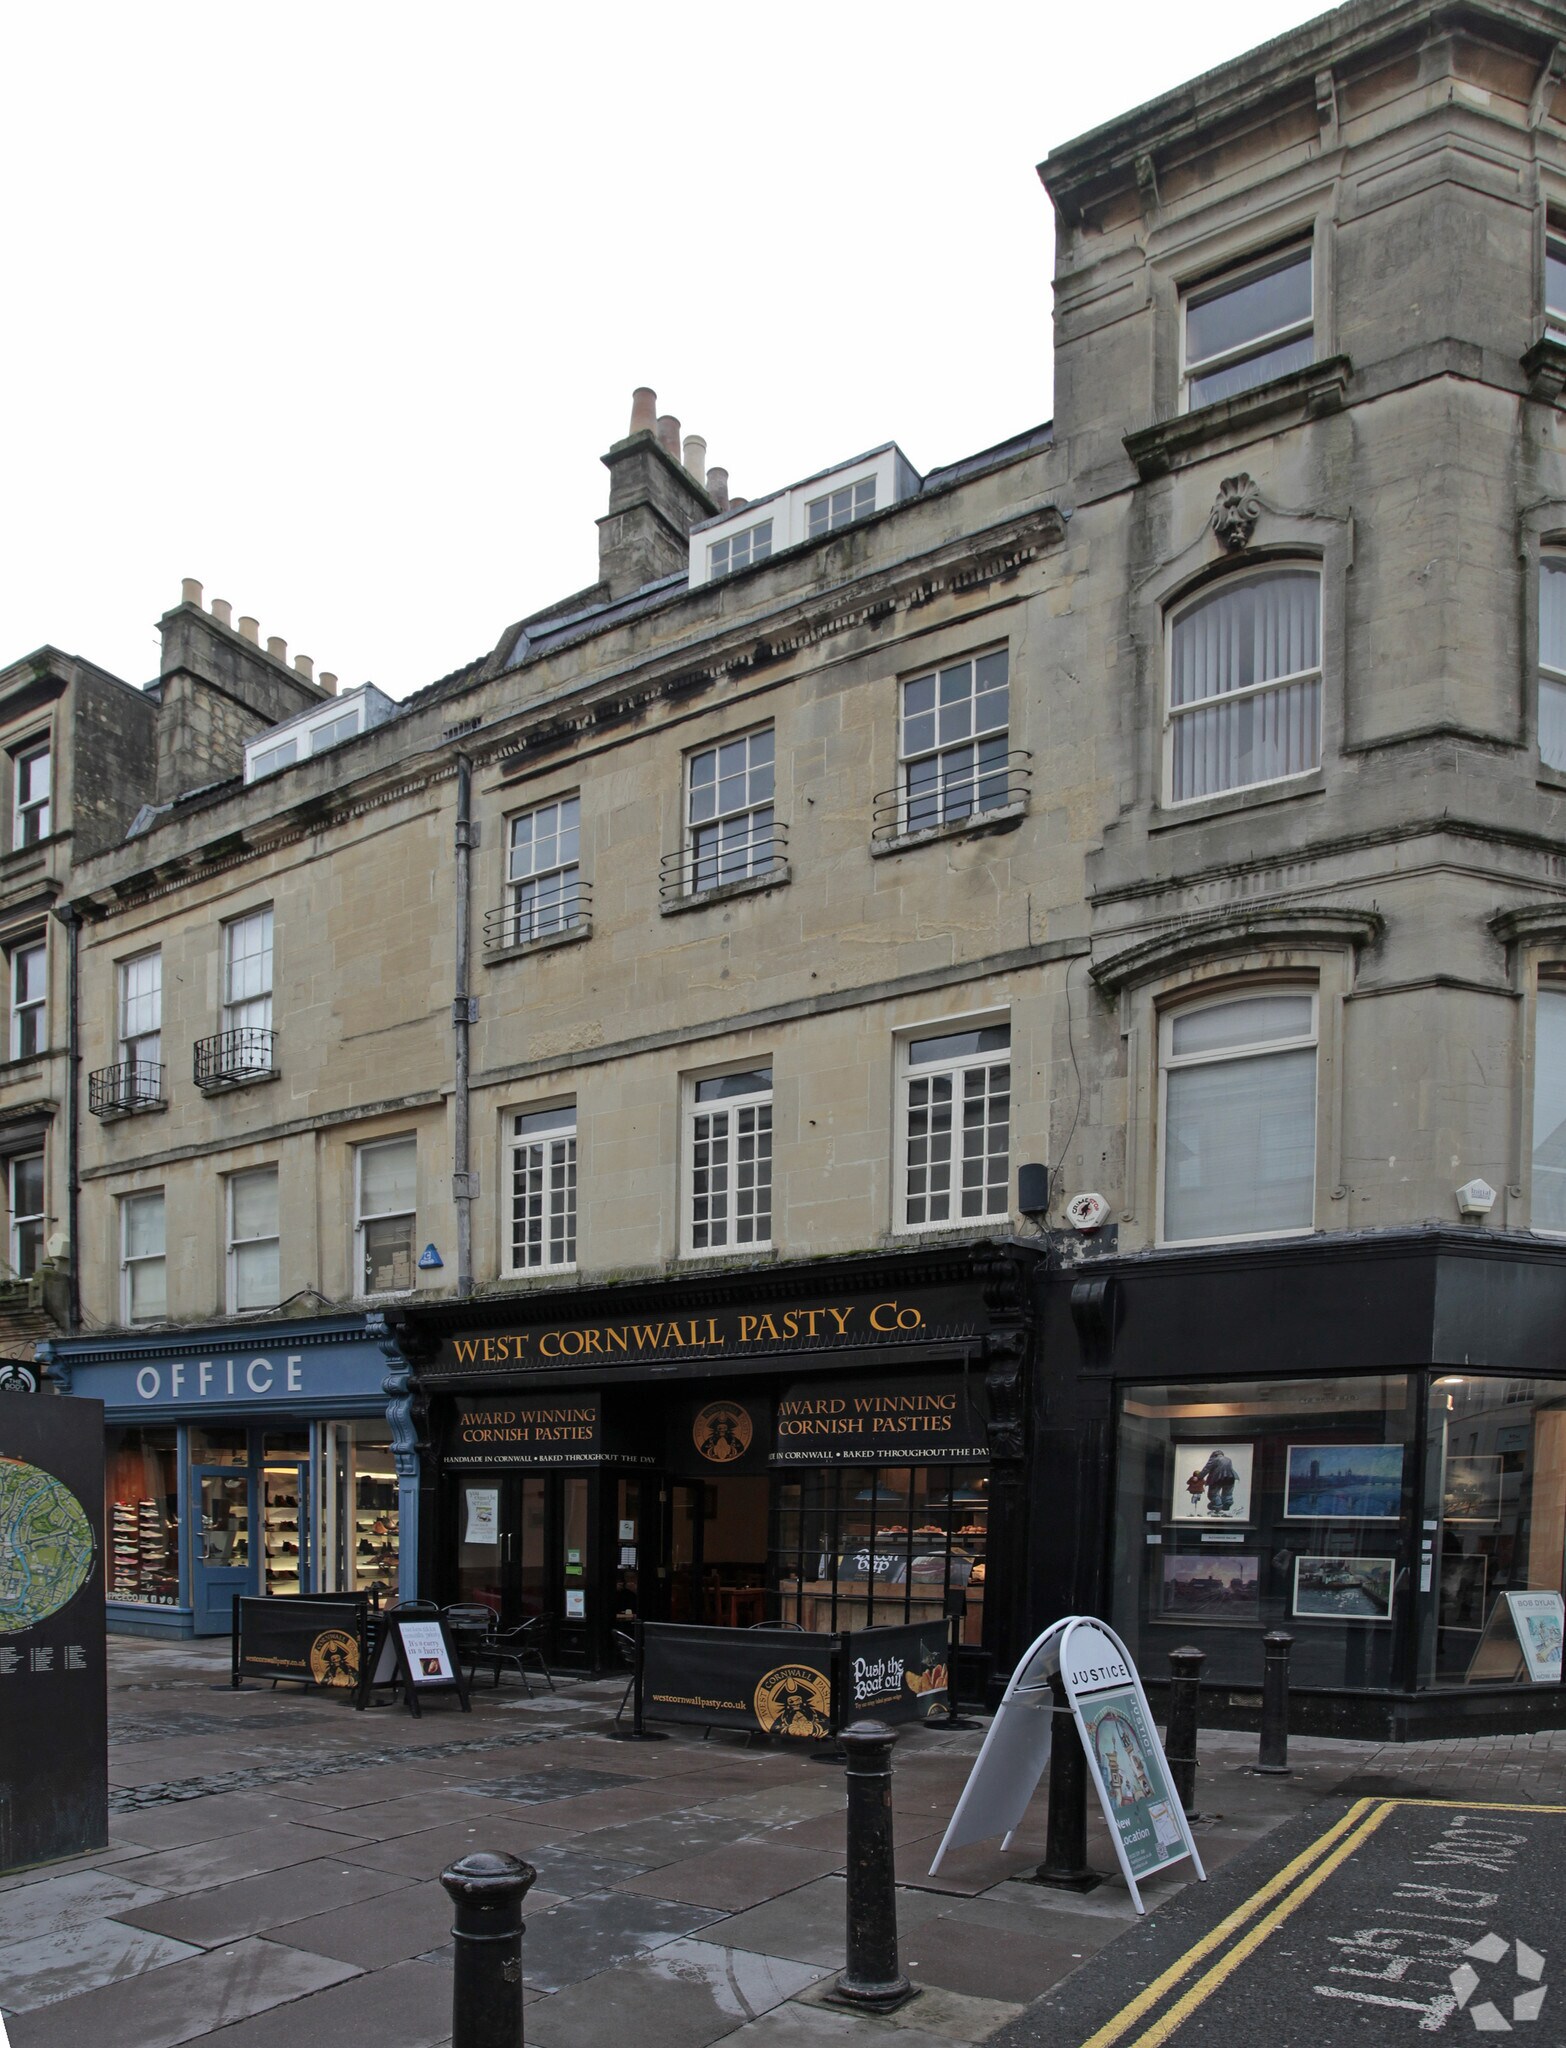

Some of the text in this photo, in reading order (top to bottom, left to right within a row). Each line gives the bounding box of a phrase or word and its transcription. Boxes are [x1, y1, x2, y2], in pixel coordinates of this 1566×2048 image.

[452, 1300, 926, 1363] WEST CORNWALL PASTY Co.
[136, 1355, 302, 1400] OFFICE
[777, 1394, 957, 1417] AWARD WINNING
[460, 1408, 596, 1426] AWARD WINNING
[778, 1415, 952, 1436] CORNISH PASTIES
[462, 1426, 593, 1442] CORNISH PASTIES
[620, 1454, 638, 1462] THE
[785, 1451, 834, 1459] CORNWALL
[843, 1450, 874, 1458] BAKED
[877, 1448, 948, 1458] THROUGHOUT
[949, 1448, 970, 1456] THE
[765, 1669, 812, 1689] CORNWALL
[852, 1656, 904, 1682] Push the
[1072, 1664, 1126, 1685] JUSTICE
[854, 1672, 903, 1700] Boat out
[652, 1692, 747, 1710] westcornwallpasty.co.uk
[1130, 1698, 1153, 1756] JUSTICE
[1409, 1815, 1535, 1874] LOOK
[1312, 1882, 1500, 2032] RIGHT
